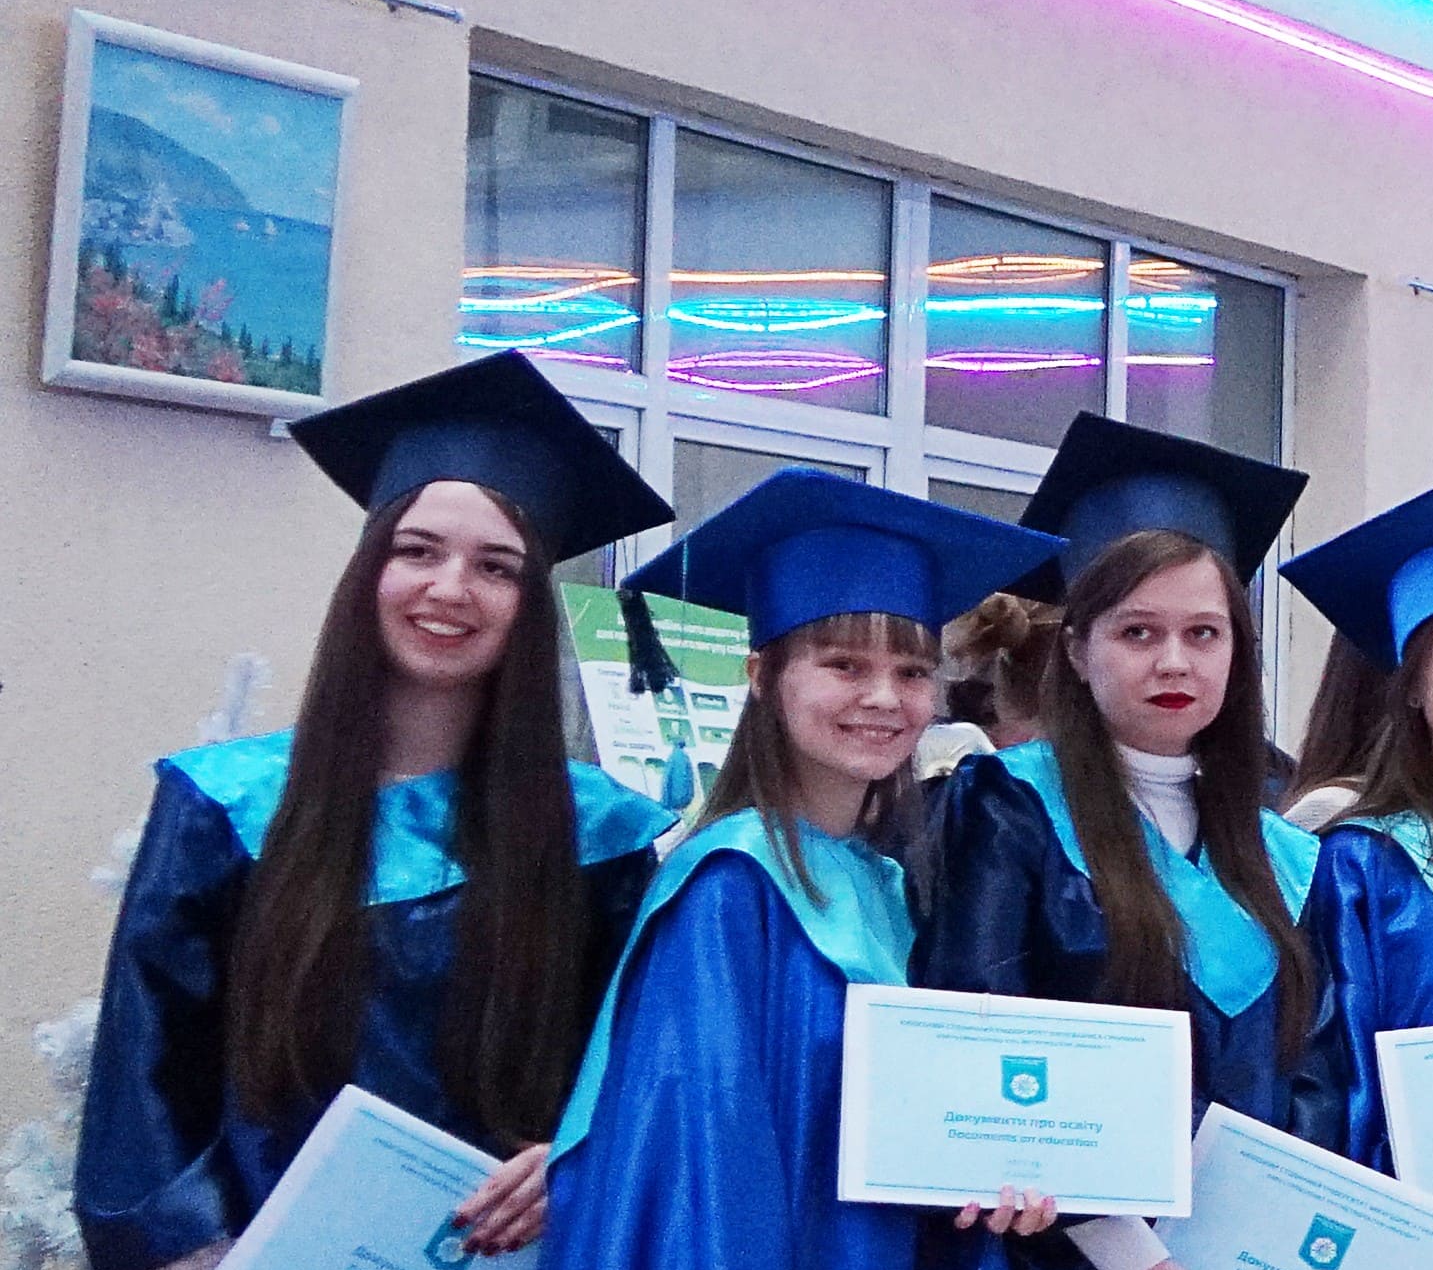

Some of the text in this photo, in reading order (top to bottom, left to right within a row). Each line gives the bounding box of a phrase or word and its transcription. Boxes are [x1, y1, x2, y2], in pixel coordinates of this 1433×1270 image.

[944, 1111, 1103, 1134] Документи про освіту
[948, 1129, 1098, 1148] Documents on education
